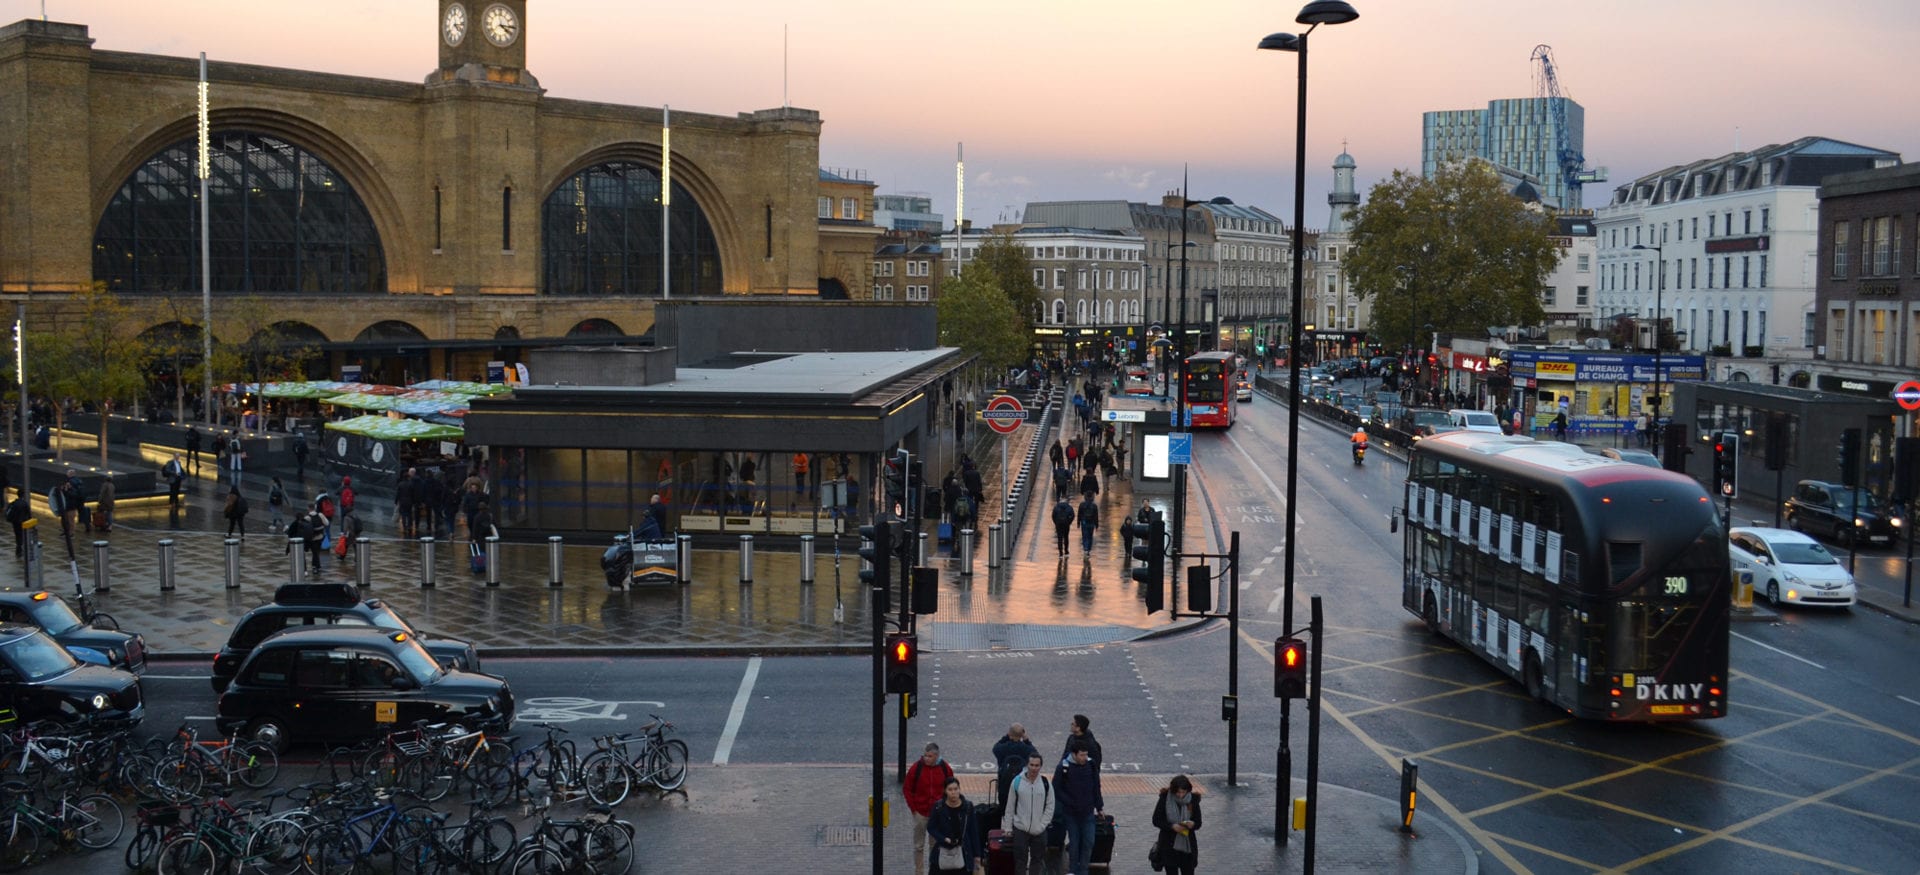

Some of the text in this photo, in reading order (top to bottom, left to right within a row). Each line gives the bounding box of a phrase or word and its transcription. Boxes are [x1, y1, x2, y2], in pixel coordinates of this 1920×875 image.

[1542, 363, 1569, 371] DHL
[1583, 364, 1625, 373] BUREAUX
[1592, 372, 1629, 380] CHANGE
[1664, 576, 1687, 594] 390
[1636, 683, 1703, 700] DKNY
